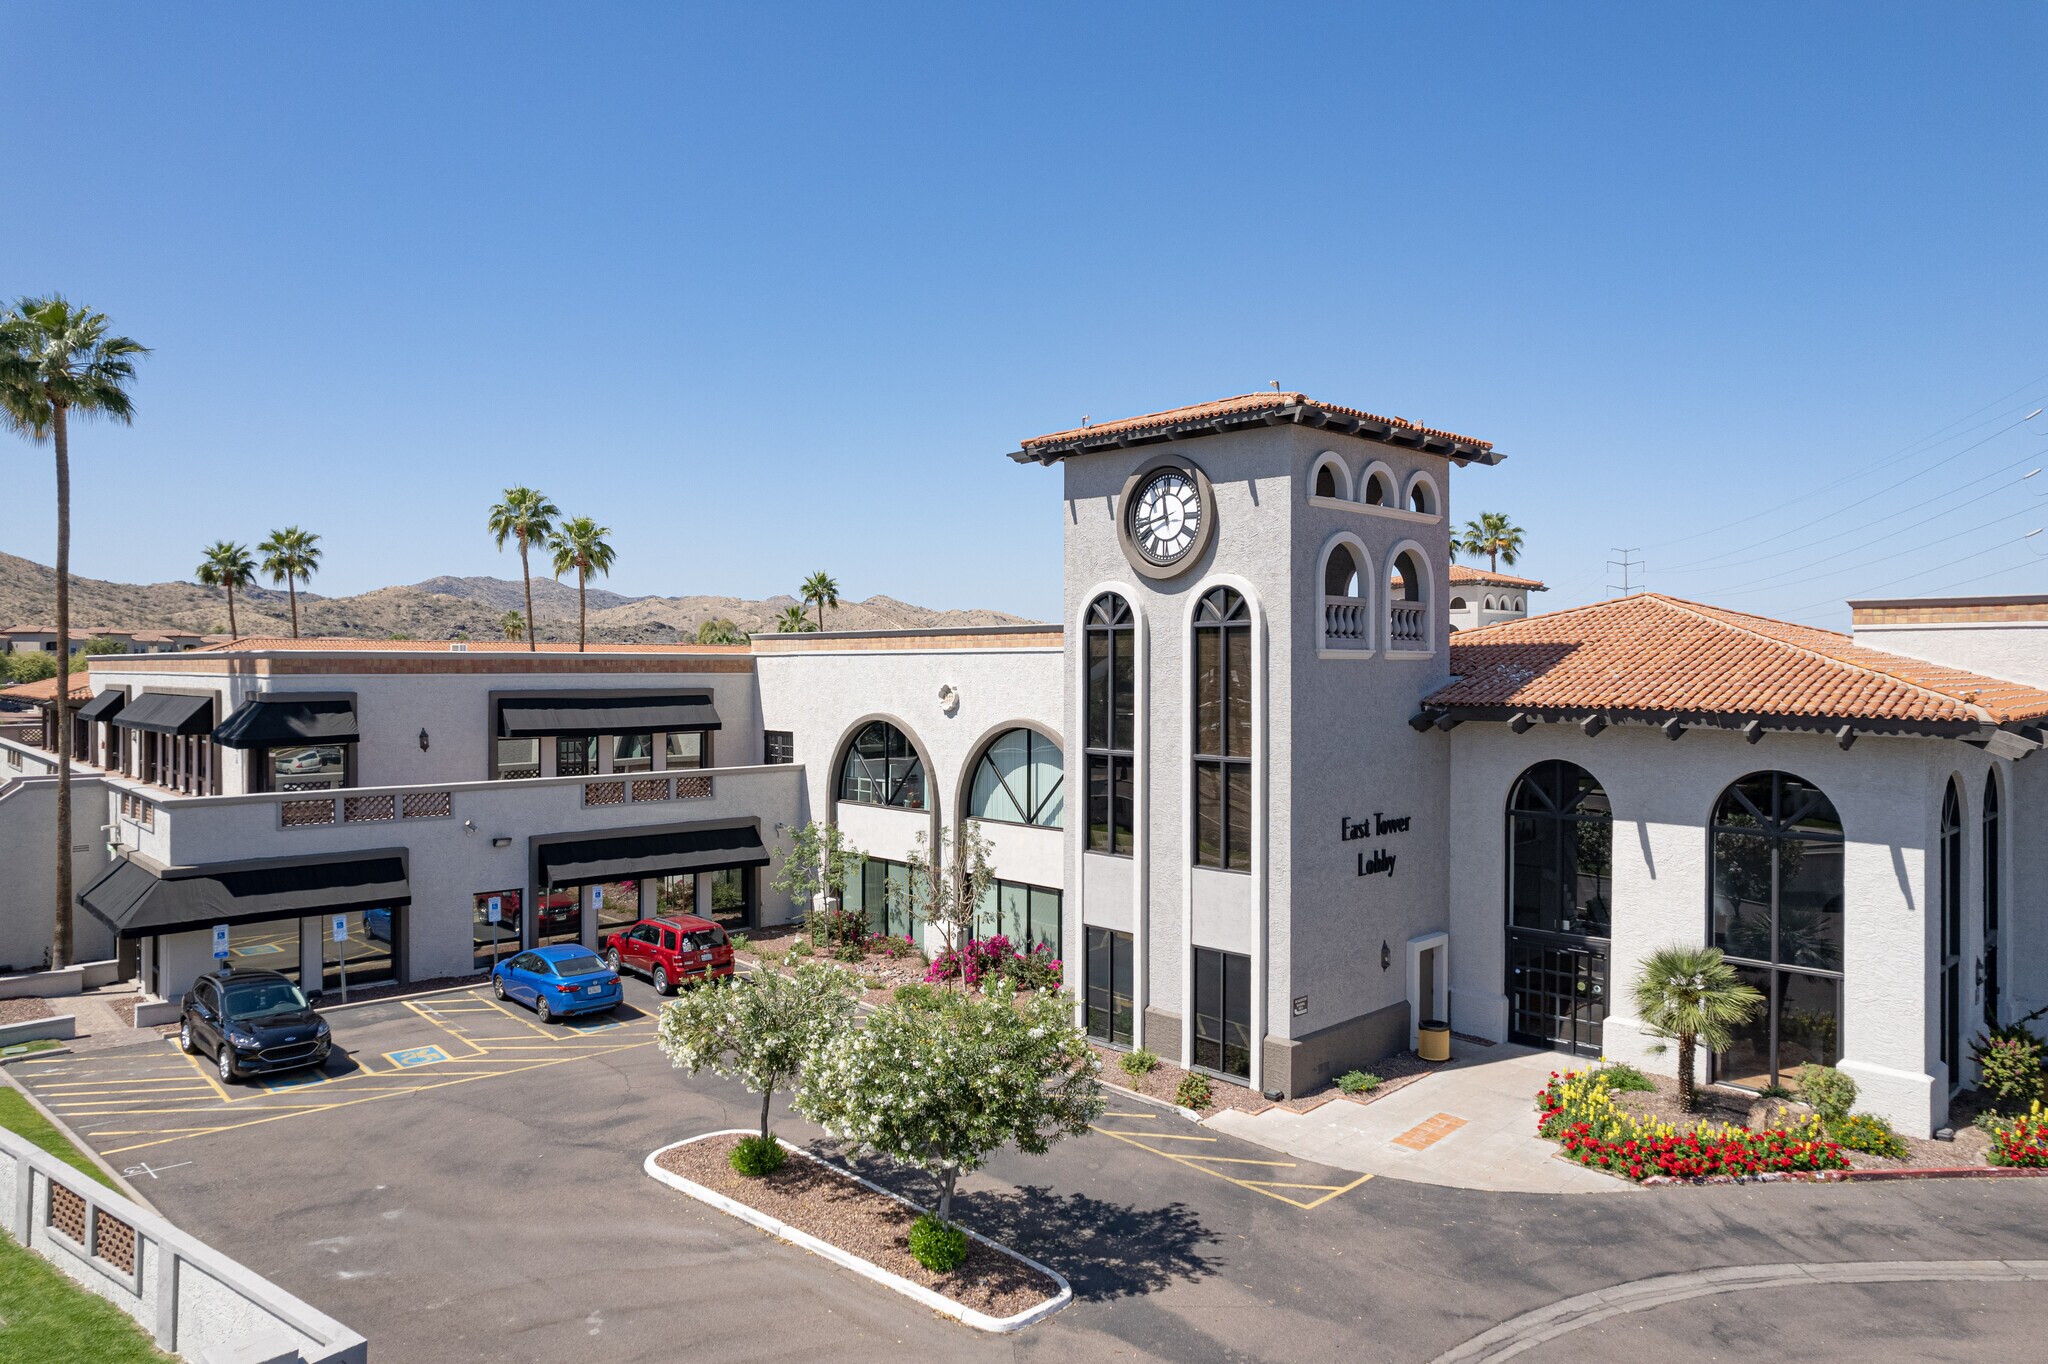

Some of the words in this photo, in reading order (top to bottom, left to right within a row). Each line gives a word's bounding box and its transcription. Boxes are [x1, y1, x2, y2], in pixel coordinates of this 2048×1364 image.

[1341, 816, 1371, 841] East
[1373, 812, 1412, 836] Tower
[1357, 848, 1397, 878] Lobby
